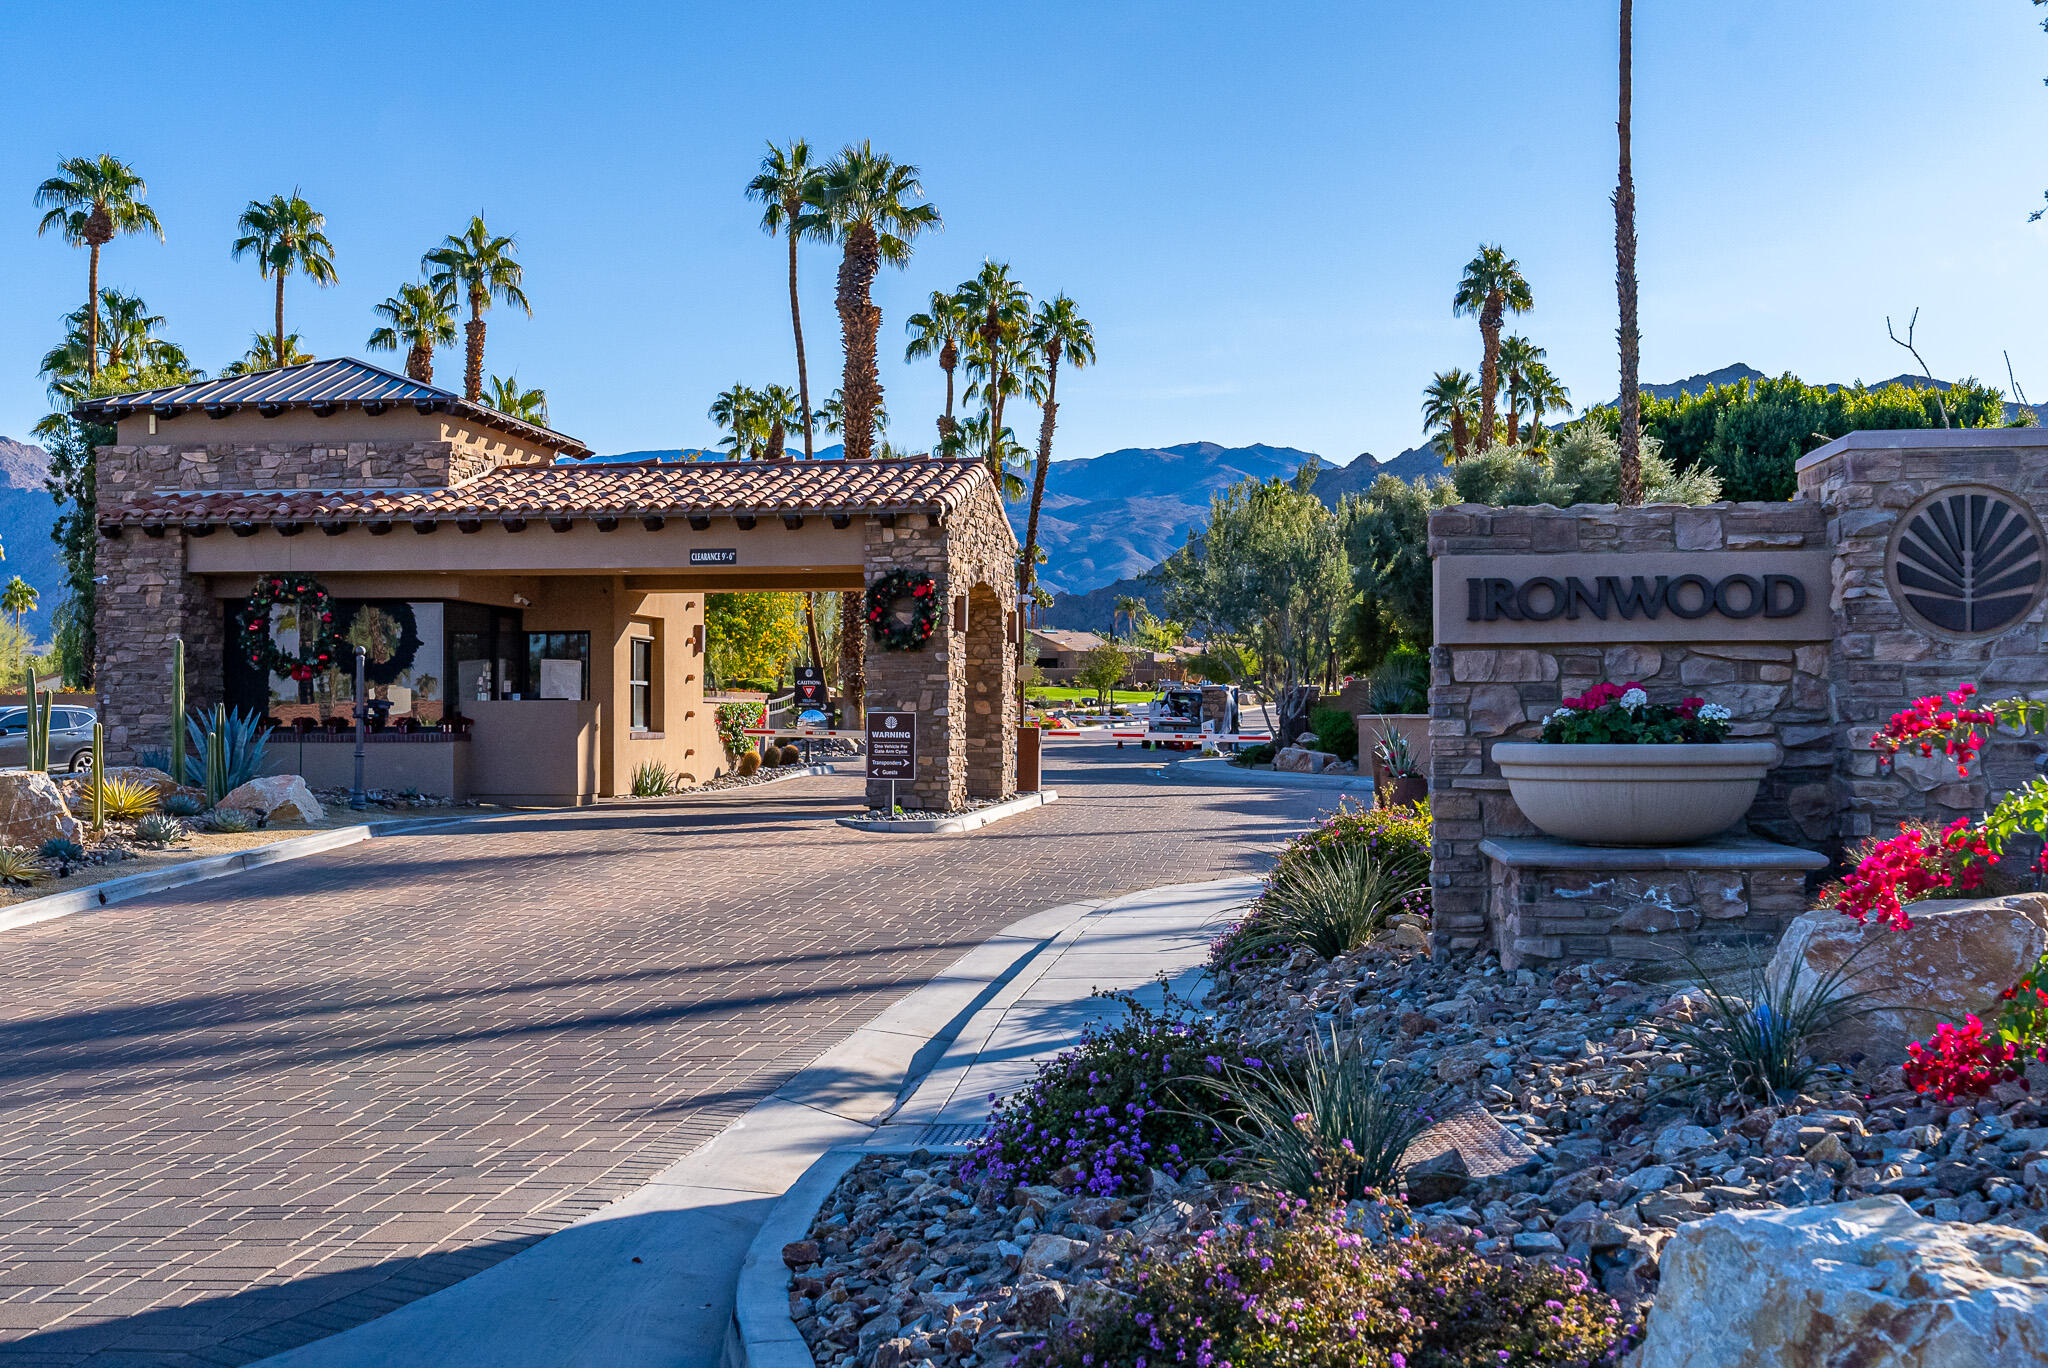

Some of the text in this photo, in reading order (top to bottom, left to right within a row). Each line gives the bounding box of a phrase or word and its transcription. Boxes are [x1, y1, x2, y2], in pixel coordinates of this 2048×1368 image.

[691, 552, 721, 561] CLEARANCE
[1466, 573, 1806, 622] IRONWOOD
[871, 731, 911, 739] WARNING
